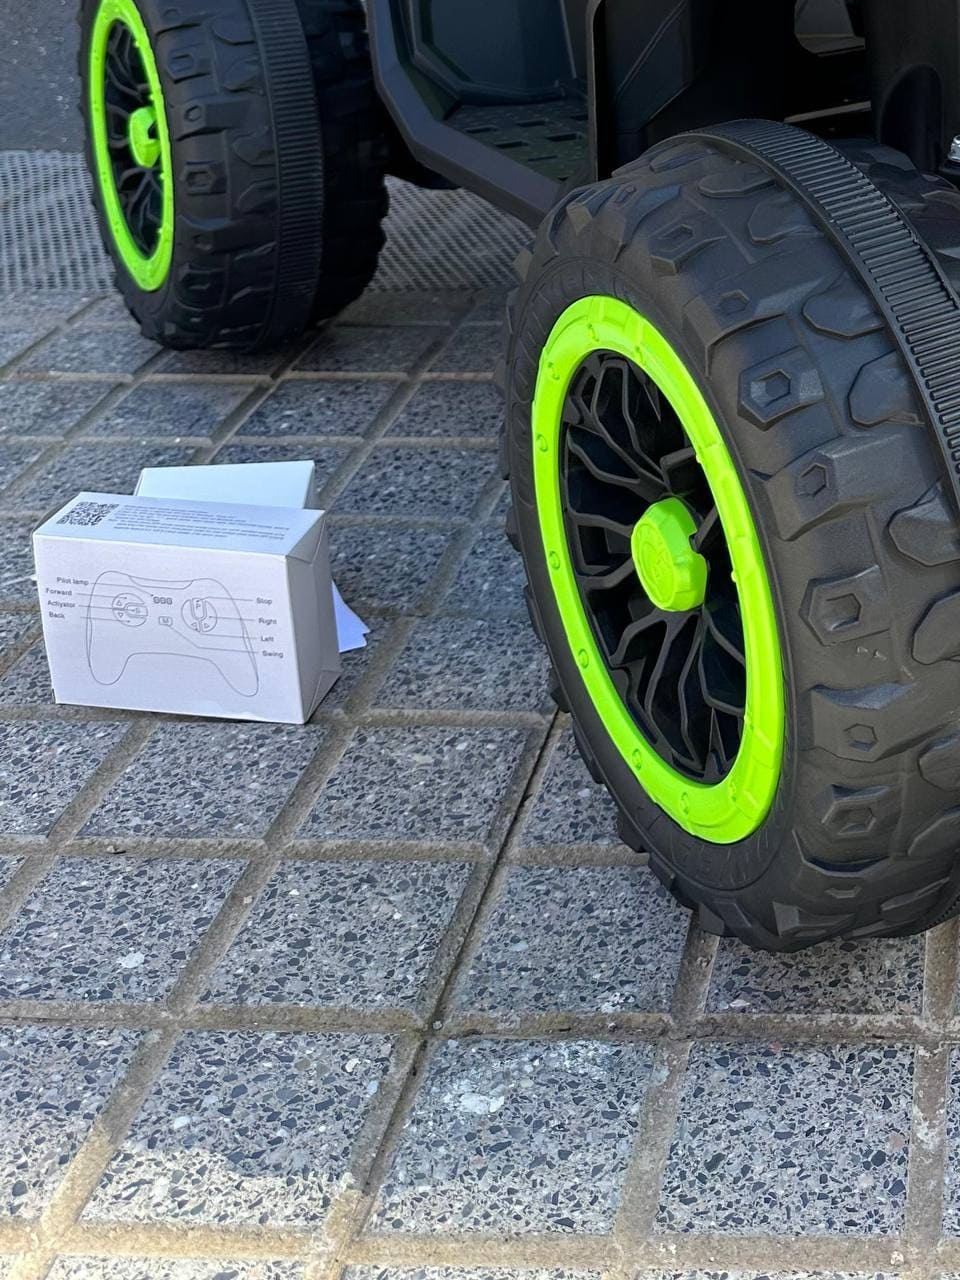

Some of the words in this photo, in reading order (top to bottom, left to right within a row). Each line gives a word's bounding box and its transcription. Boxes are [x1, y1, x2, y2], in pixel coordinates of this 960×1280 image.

[46, 588, 72, 596] Forward
[49, 611, 65, 619] Back
[262, 650, 284, 659] Swing
